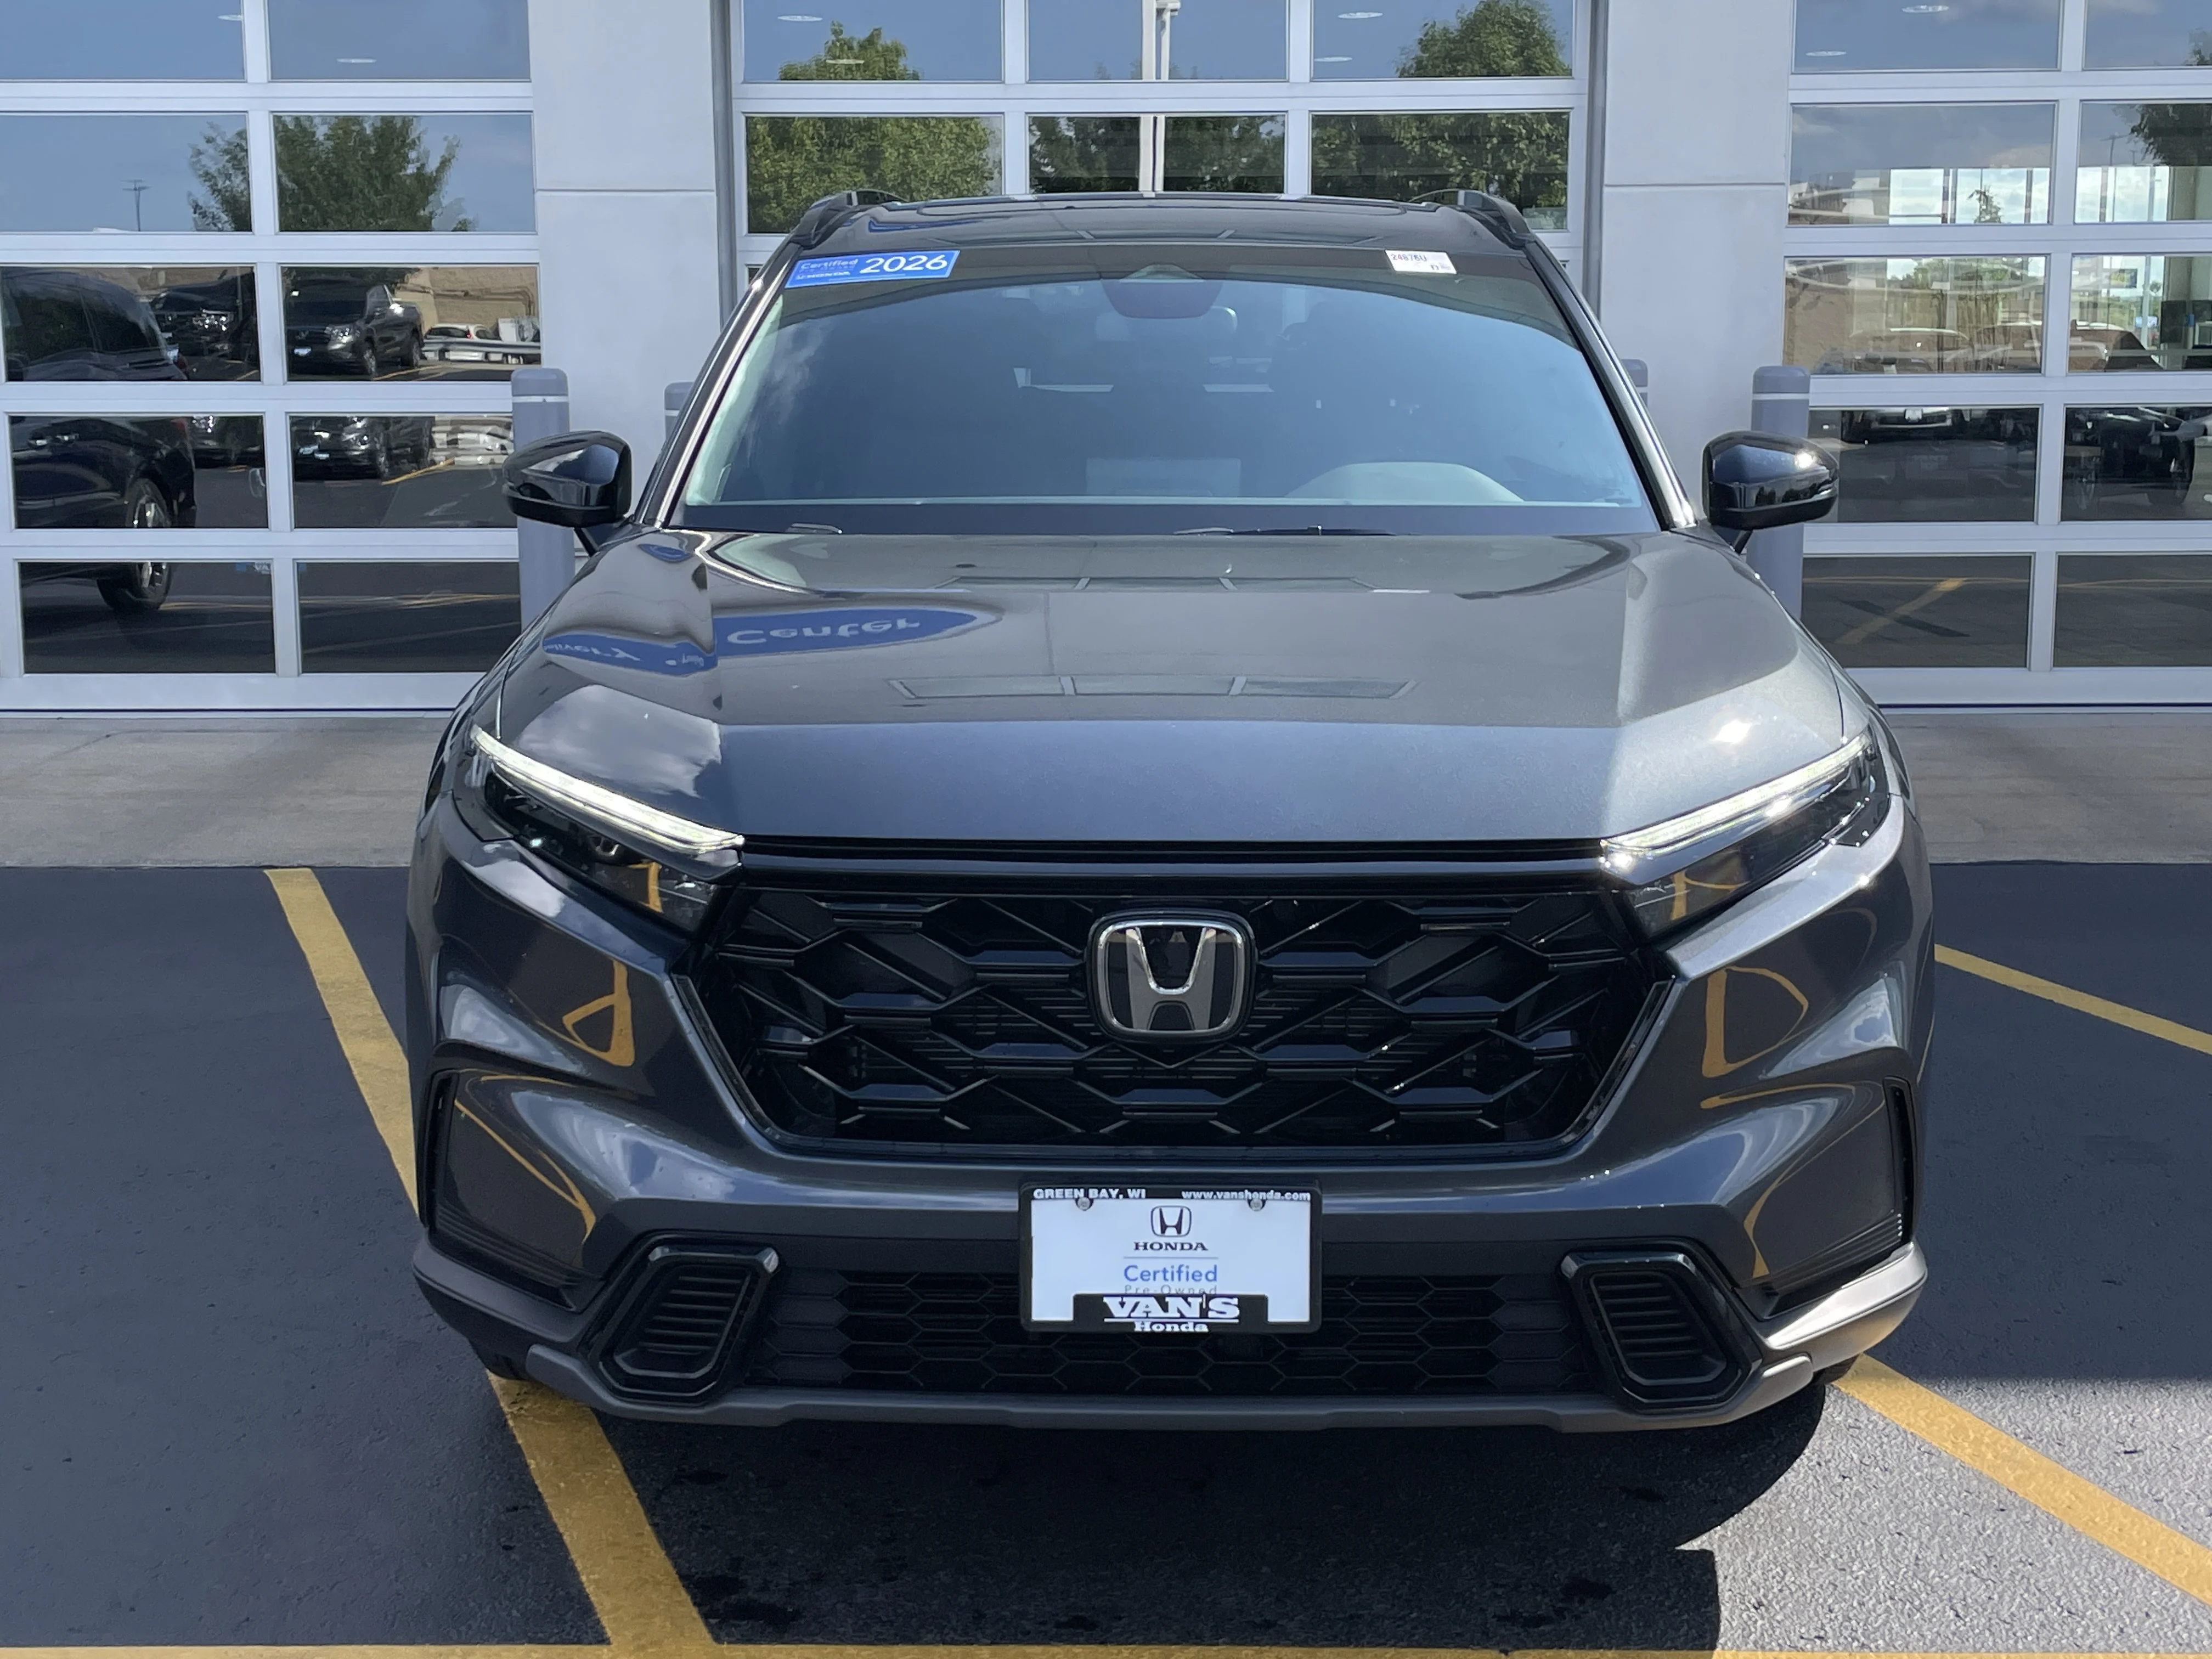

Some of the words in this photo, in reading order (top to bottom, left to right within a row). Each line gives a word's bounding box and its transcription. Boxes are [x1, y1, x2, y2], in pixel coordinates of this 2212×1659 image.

[800, 259, 859, 270] Certified
[860, 255, 947, 274] 2026
[1033, 1188, 1085, 1198] GREEN
[1088, 1188, 1124, 1200] BAY,
[1127, 1189, 1146, 1198] WI
[1181, 1189, 1311, 1201] www.vanshonda.com
[1133, 1242, 1209, 1251] HONDA
[1124, 1264, 1217, 1282] Certified
[1125, 1284, 1217, 1295] Pre-Owned
[1103, 1294, 1240, 1318] VAN'S
[1134, 1321, 1209, 1331] Honda
